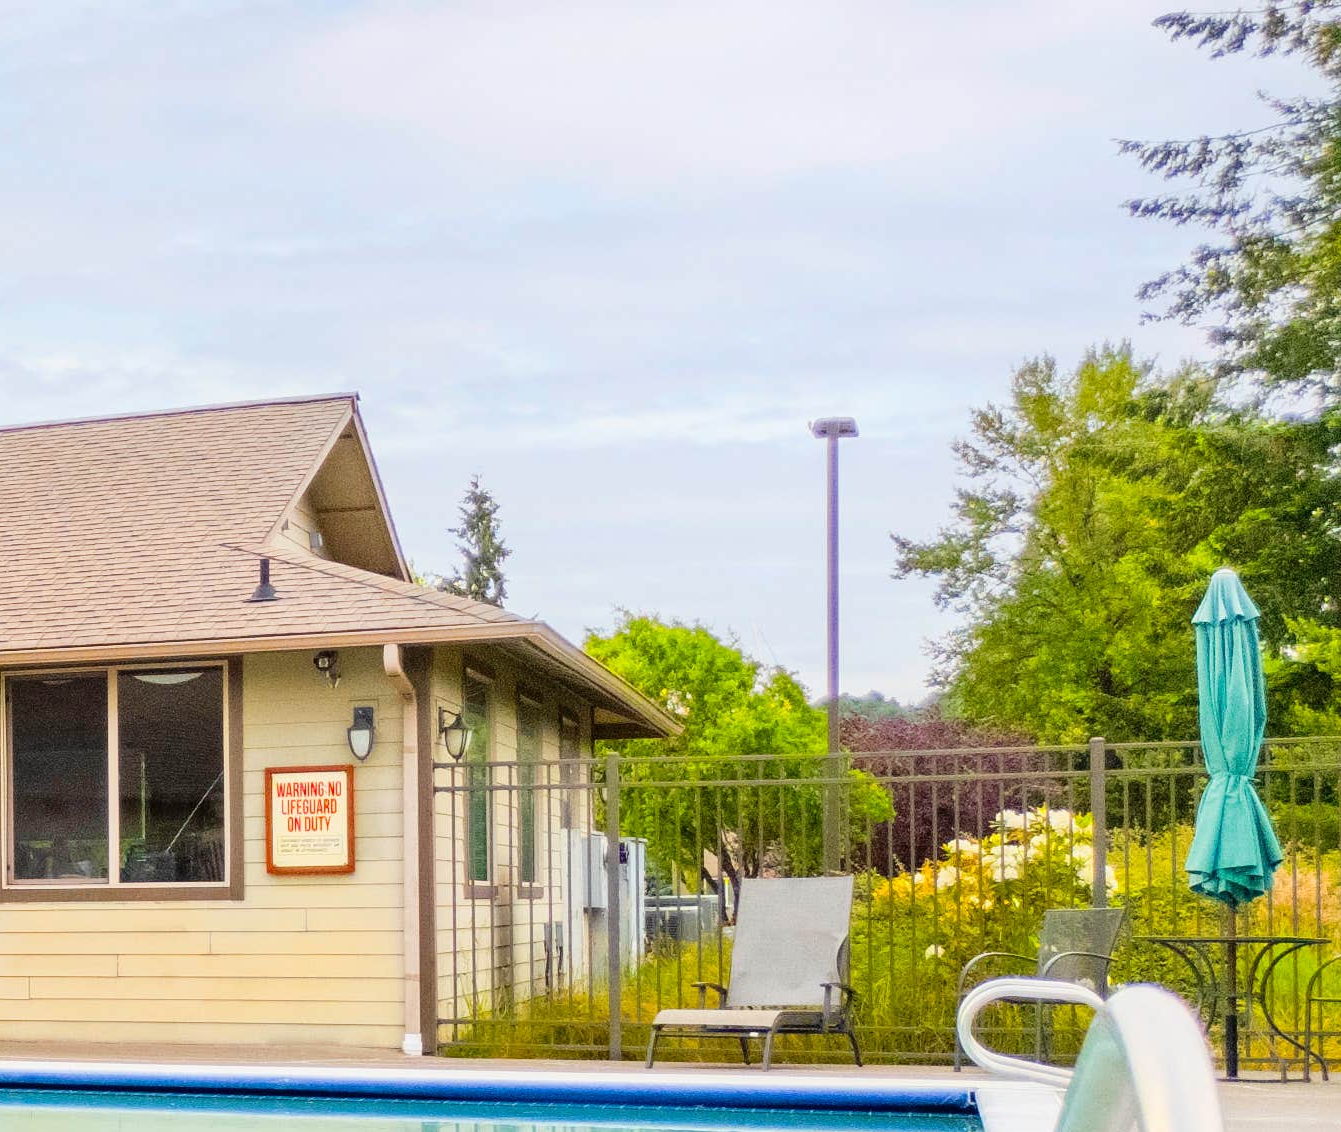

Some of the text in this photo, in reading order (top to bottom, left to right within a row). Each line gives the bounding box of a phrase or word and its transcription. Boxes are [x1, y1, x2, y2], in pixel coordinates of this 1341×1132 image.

[277, 781, 342, 798] WARNING NO
[281, 798, 338, 815] LIFEGUARD
[287, 815, 331, 833] ON DUTY
